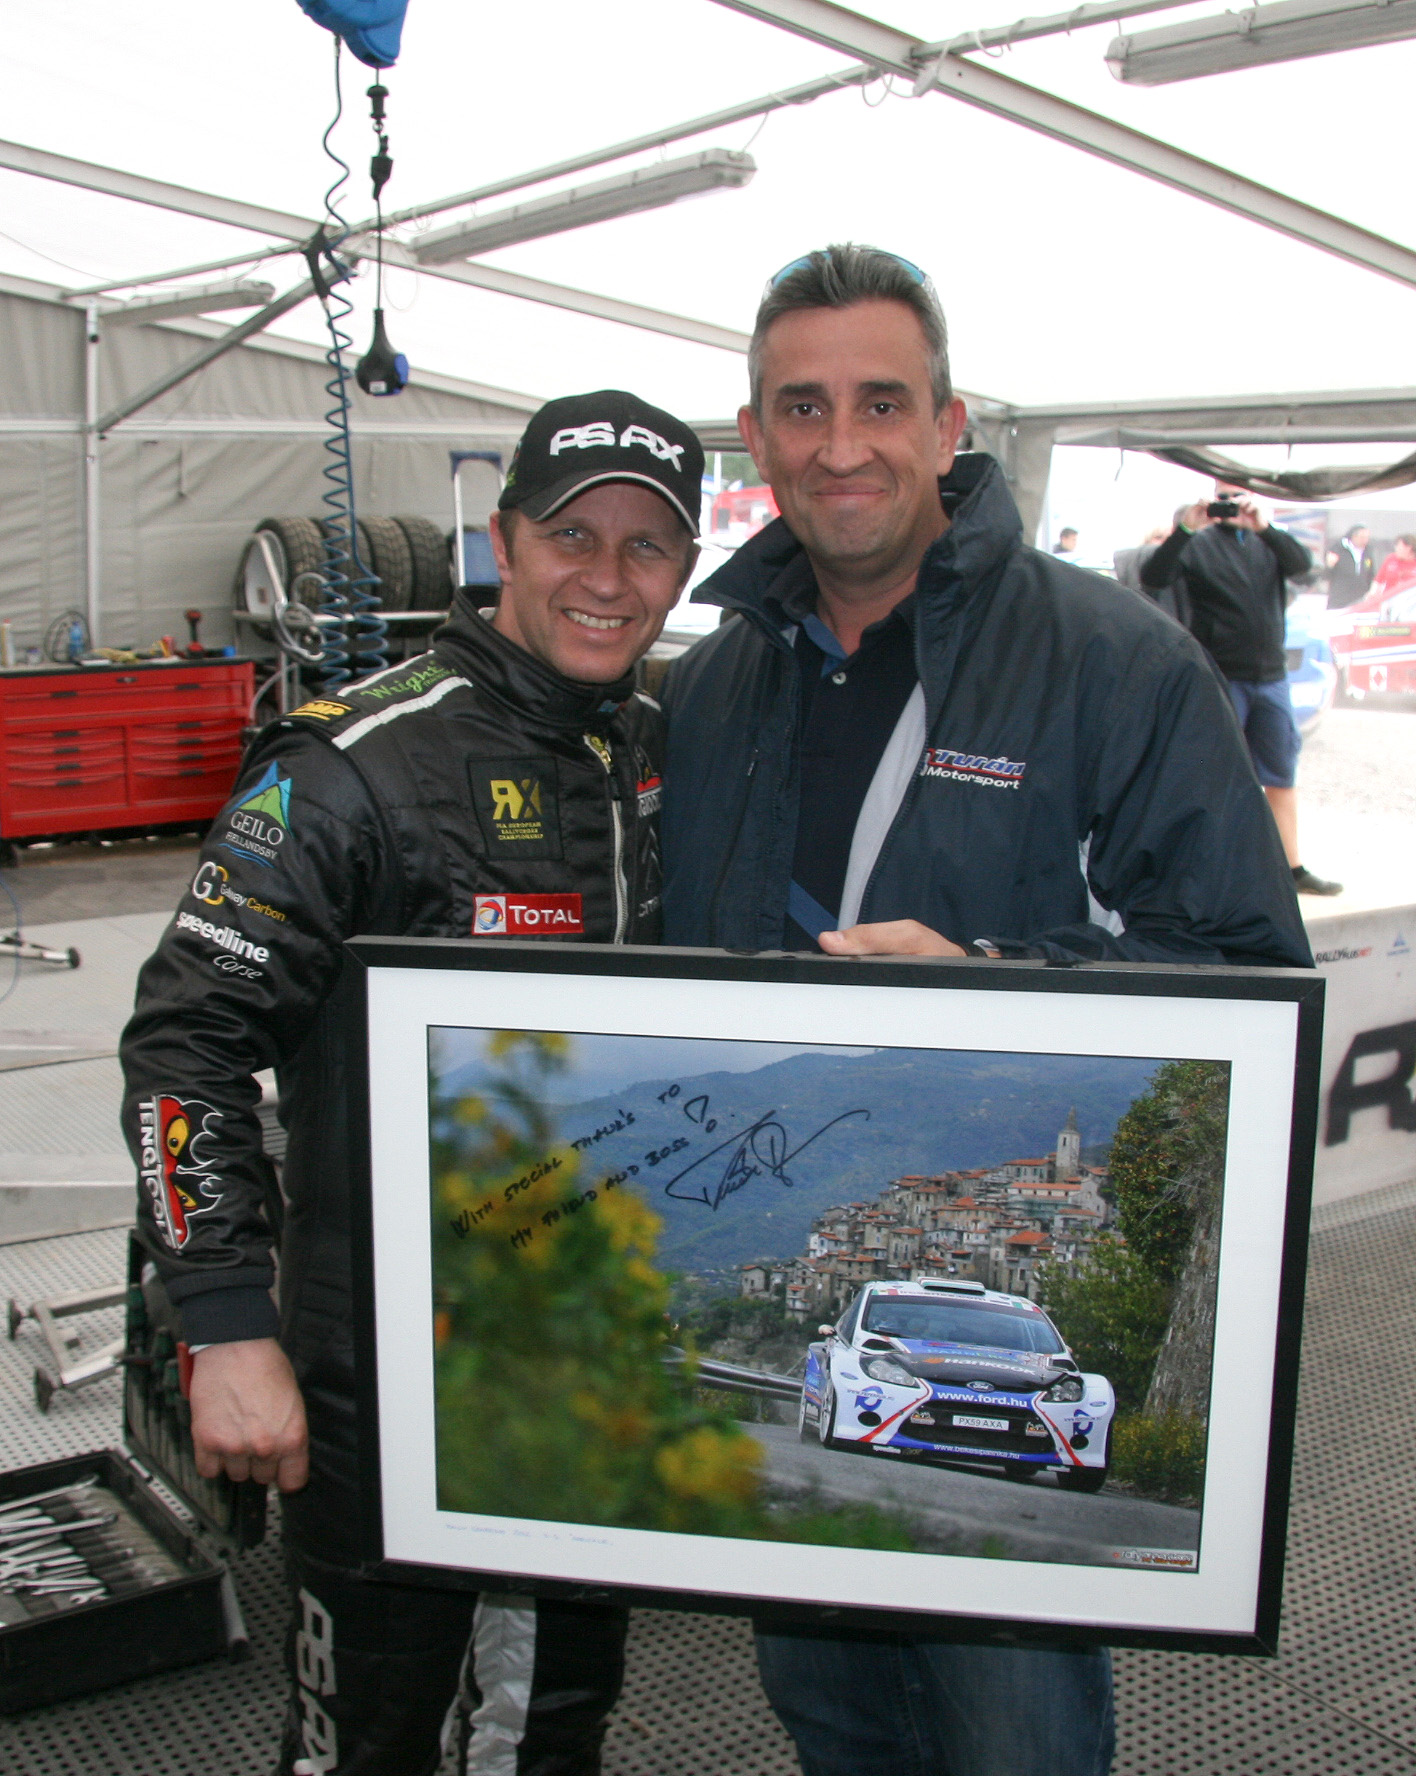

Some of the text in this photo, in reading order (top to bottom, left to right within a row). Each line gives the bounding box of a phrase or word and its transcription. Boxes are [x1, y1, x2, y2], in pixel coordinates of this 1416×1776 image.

[927, 767, 1020, 789] Motorsport
[230, 811, 285, 846] GEILO
[220, 883, 287, 922] Galway Carbon
[508, 905, 580, 925] TOTAL
[176, 911, 270, 963] speedline
[213, 954, 264, 979] Corse
[1324, 1018, 1416, 1147] R
[450, 1201, 493, 1239] WITH
[657, 1084, 681, 1105] TO
[510, 1227, 534, 1248] MY
[605, 1164, 640, 1190] AND
[937, 1391, 1028, 1408] www.ford.hu
[958, 1417, 1004, 1430] PX59 AXA
